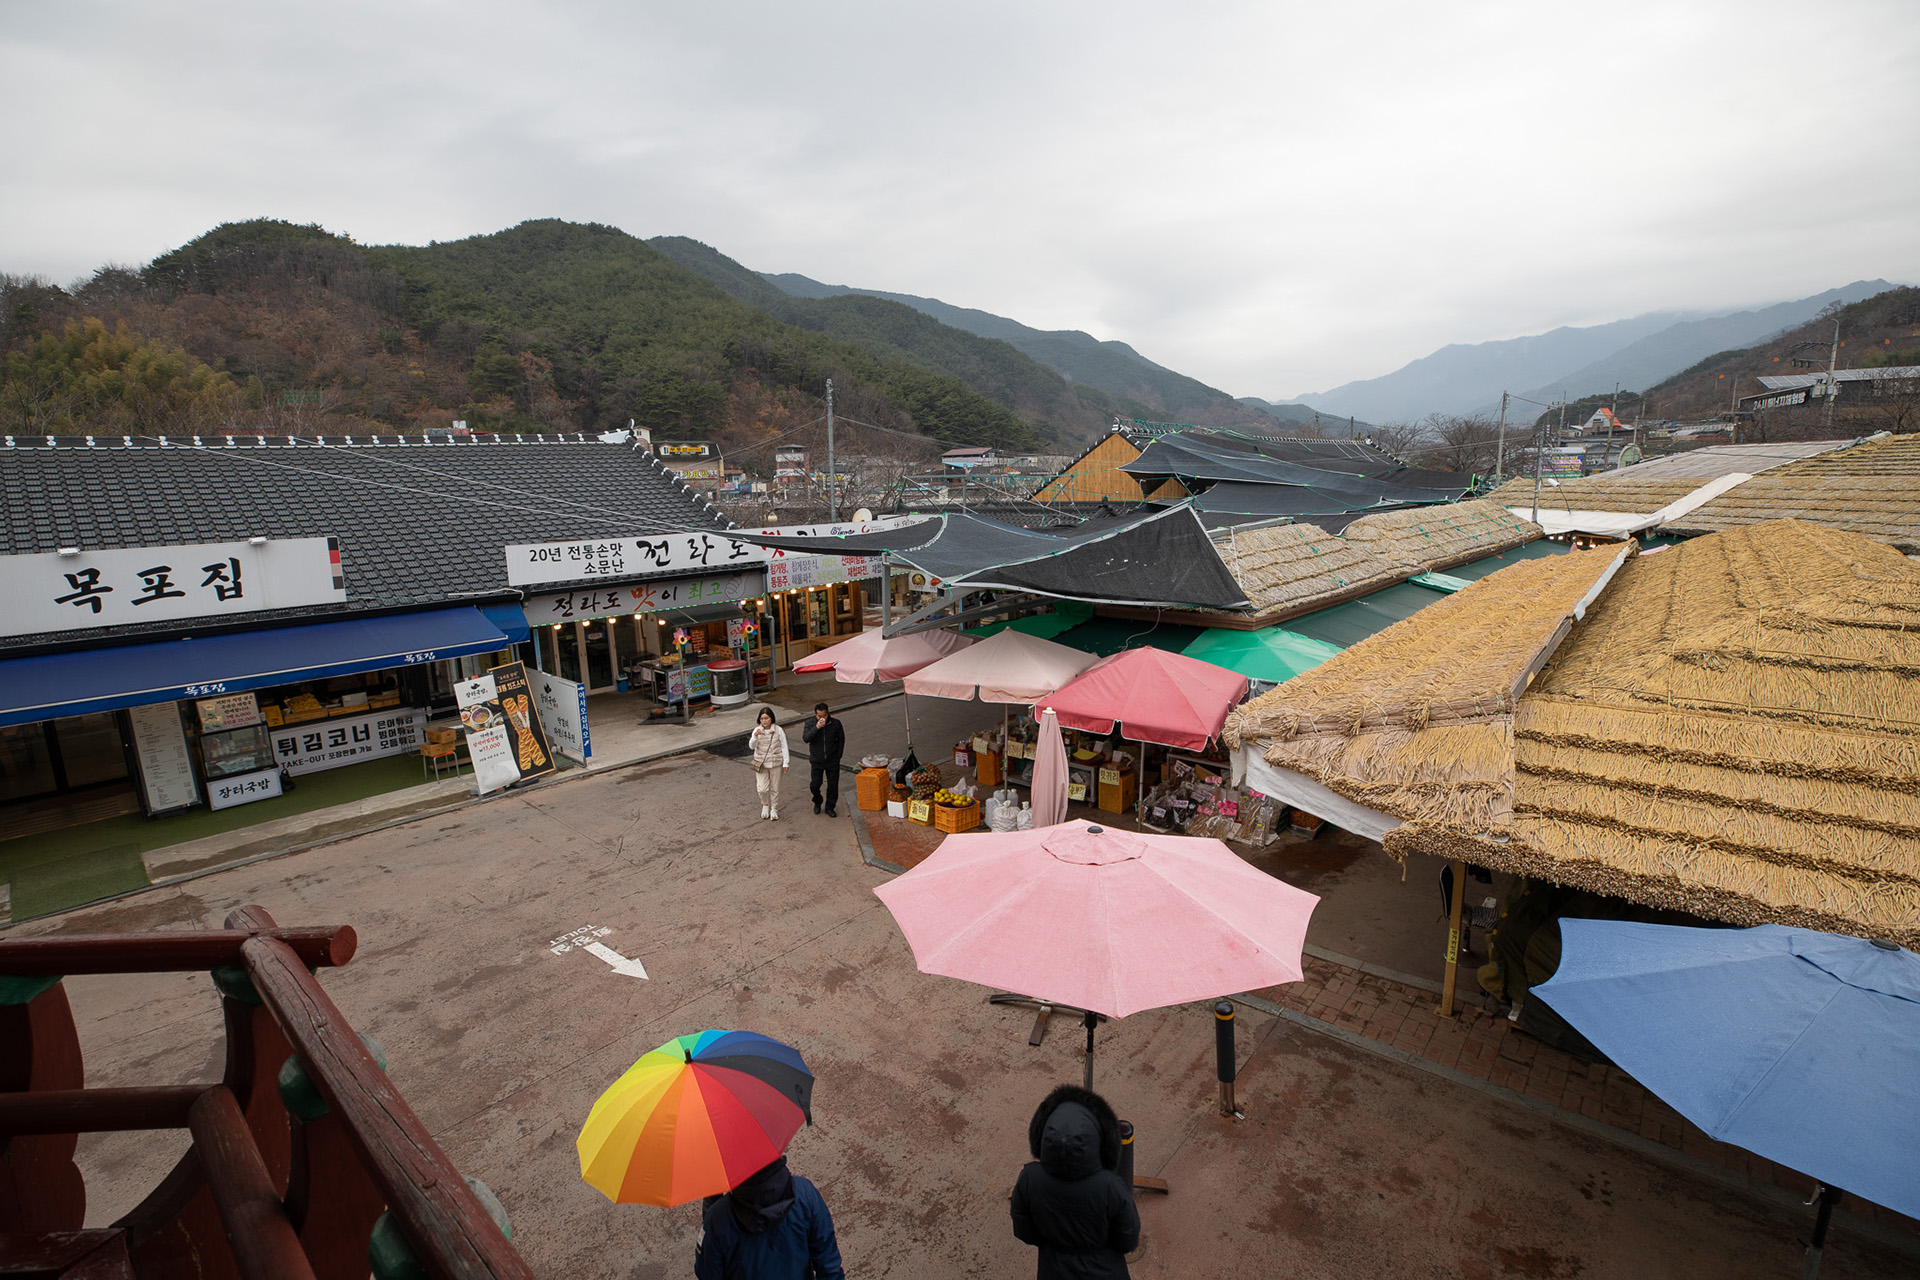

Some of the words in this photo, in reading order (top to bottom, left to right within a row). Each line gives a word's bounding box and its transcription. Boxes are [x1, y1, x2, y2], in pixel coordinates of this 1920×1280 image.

[529, 547, 562, 562] 20년
[567, 542, 623, 561] 전통손맛
[583, 559, 625, 574] 소문난
[53, 556, 244, 614] 목포집
[552, 591, 621, 617] 전라도
[687, 581, 723, 600] 최고
[184, 683, 226, 696] 목포집
[377, 716, 414, 730] 은어튀김
[277, 723, 371, 757] 튀김코너
[281, 754, 326, 769] TAKE-OUT
[328, 748, 357, 760] 포장판매
[358, 745, 373, 754] 가능
[219, 778, 270, 799] 장터국밥
[550, 924, 597, 947] TOILET
